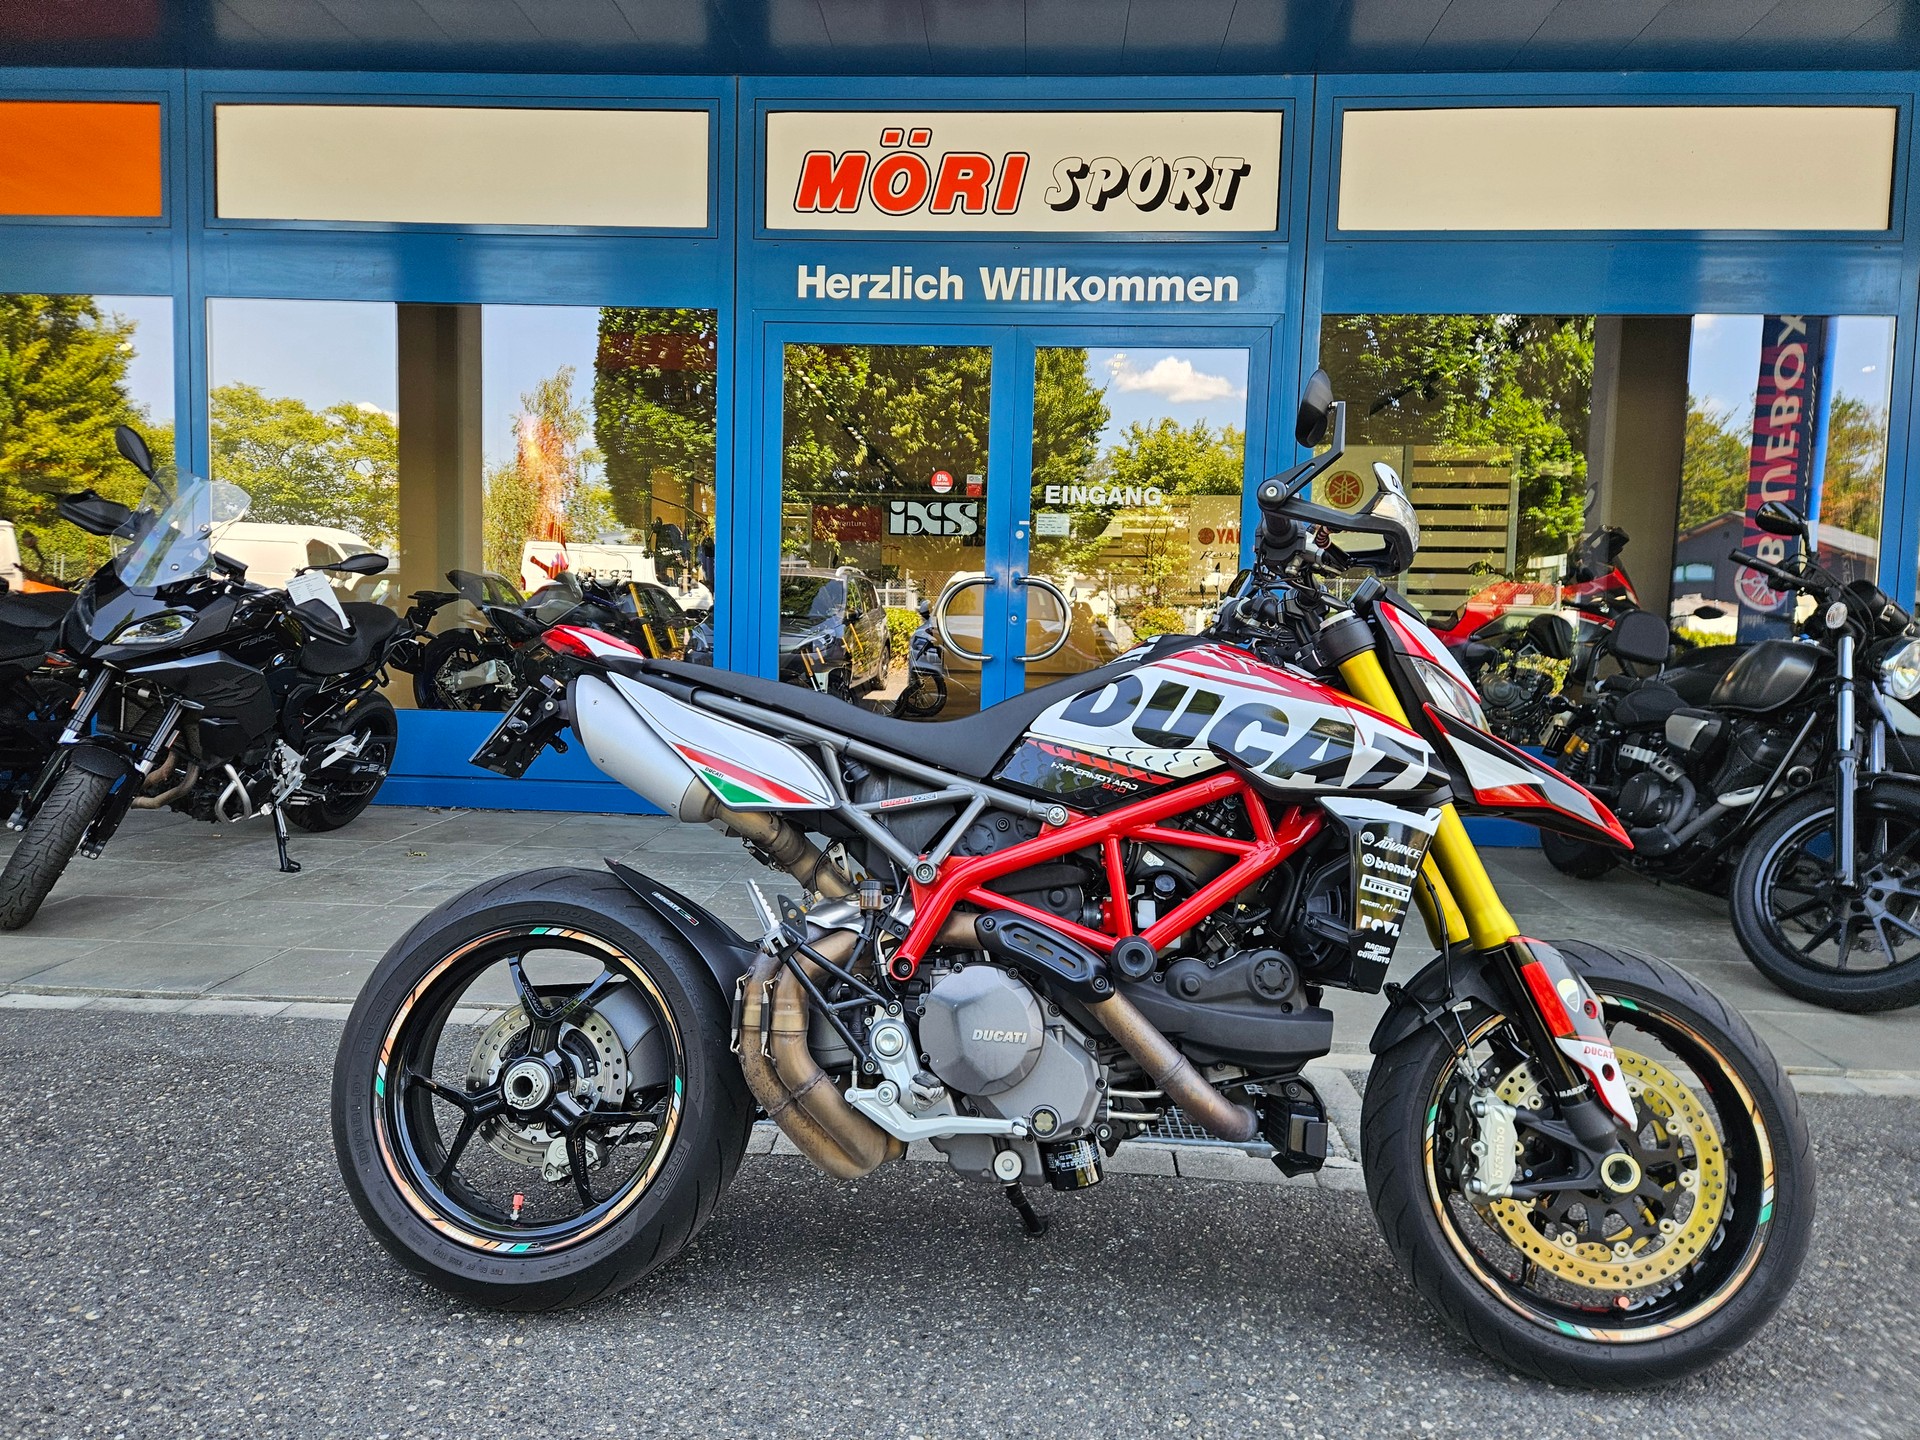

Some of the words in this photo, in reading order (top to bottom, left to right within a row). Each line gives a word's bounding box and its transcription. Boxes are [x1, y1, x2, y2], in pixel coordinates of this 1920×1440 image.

[794, 128, 1030, 216] MÖRI
[1044, 156, 1251, 215] SPORT
[798, 265, 964, 300] Herzlich
[979, 266, 1239, 303] Willkommen
[1045, 485, 1161, 506] EINGANG
[1060, 675, 1448, 790] DUCATI
[704, 766, 725, 779] DUCATI
[1374, 839, 1423, 859] ADVANCE
[1374, 856, 1418, 879] brembo
[1363, 877, 1409, 899] PIRELLI
[1357, 950, 1391, 965] COWBOYS
[1364, 941, 1391, 959] RACING
[971, 1029, 1028, 1044] DUCATI
[1583, 1045, 1617, 1060] DUCATI
[1491, 1126, 1505, 1179] brembo
